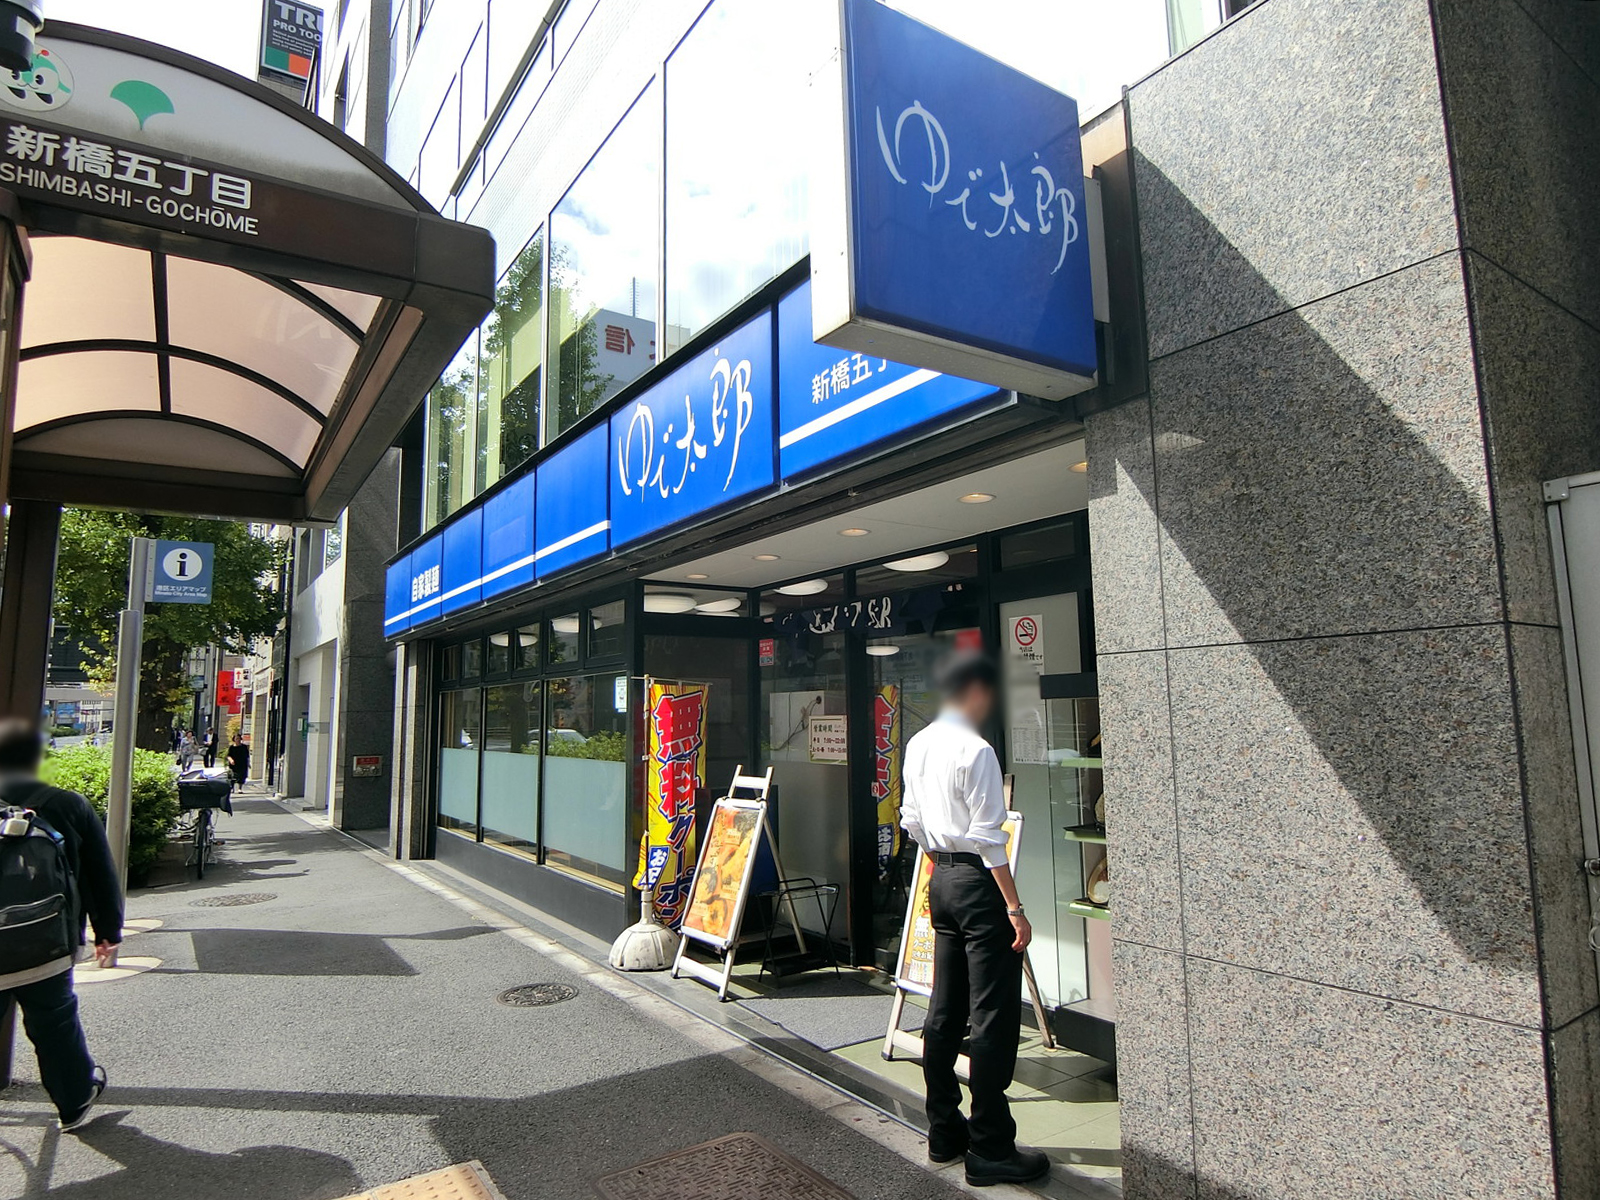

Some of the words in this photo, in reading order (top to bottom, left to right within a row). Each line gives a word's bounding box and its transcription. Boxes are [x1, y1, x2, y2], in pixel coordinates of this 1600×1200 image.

[273, 19, 297, 33] PRO
[7, 124, 252, 210] 新橋五丁目
[876, 99, 1079, 275] ゆで太郎
[618, 347, 753, 503] ゆで太郎
